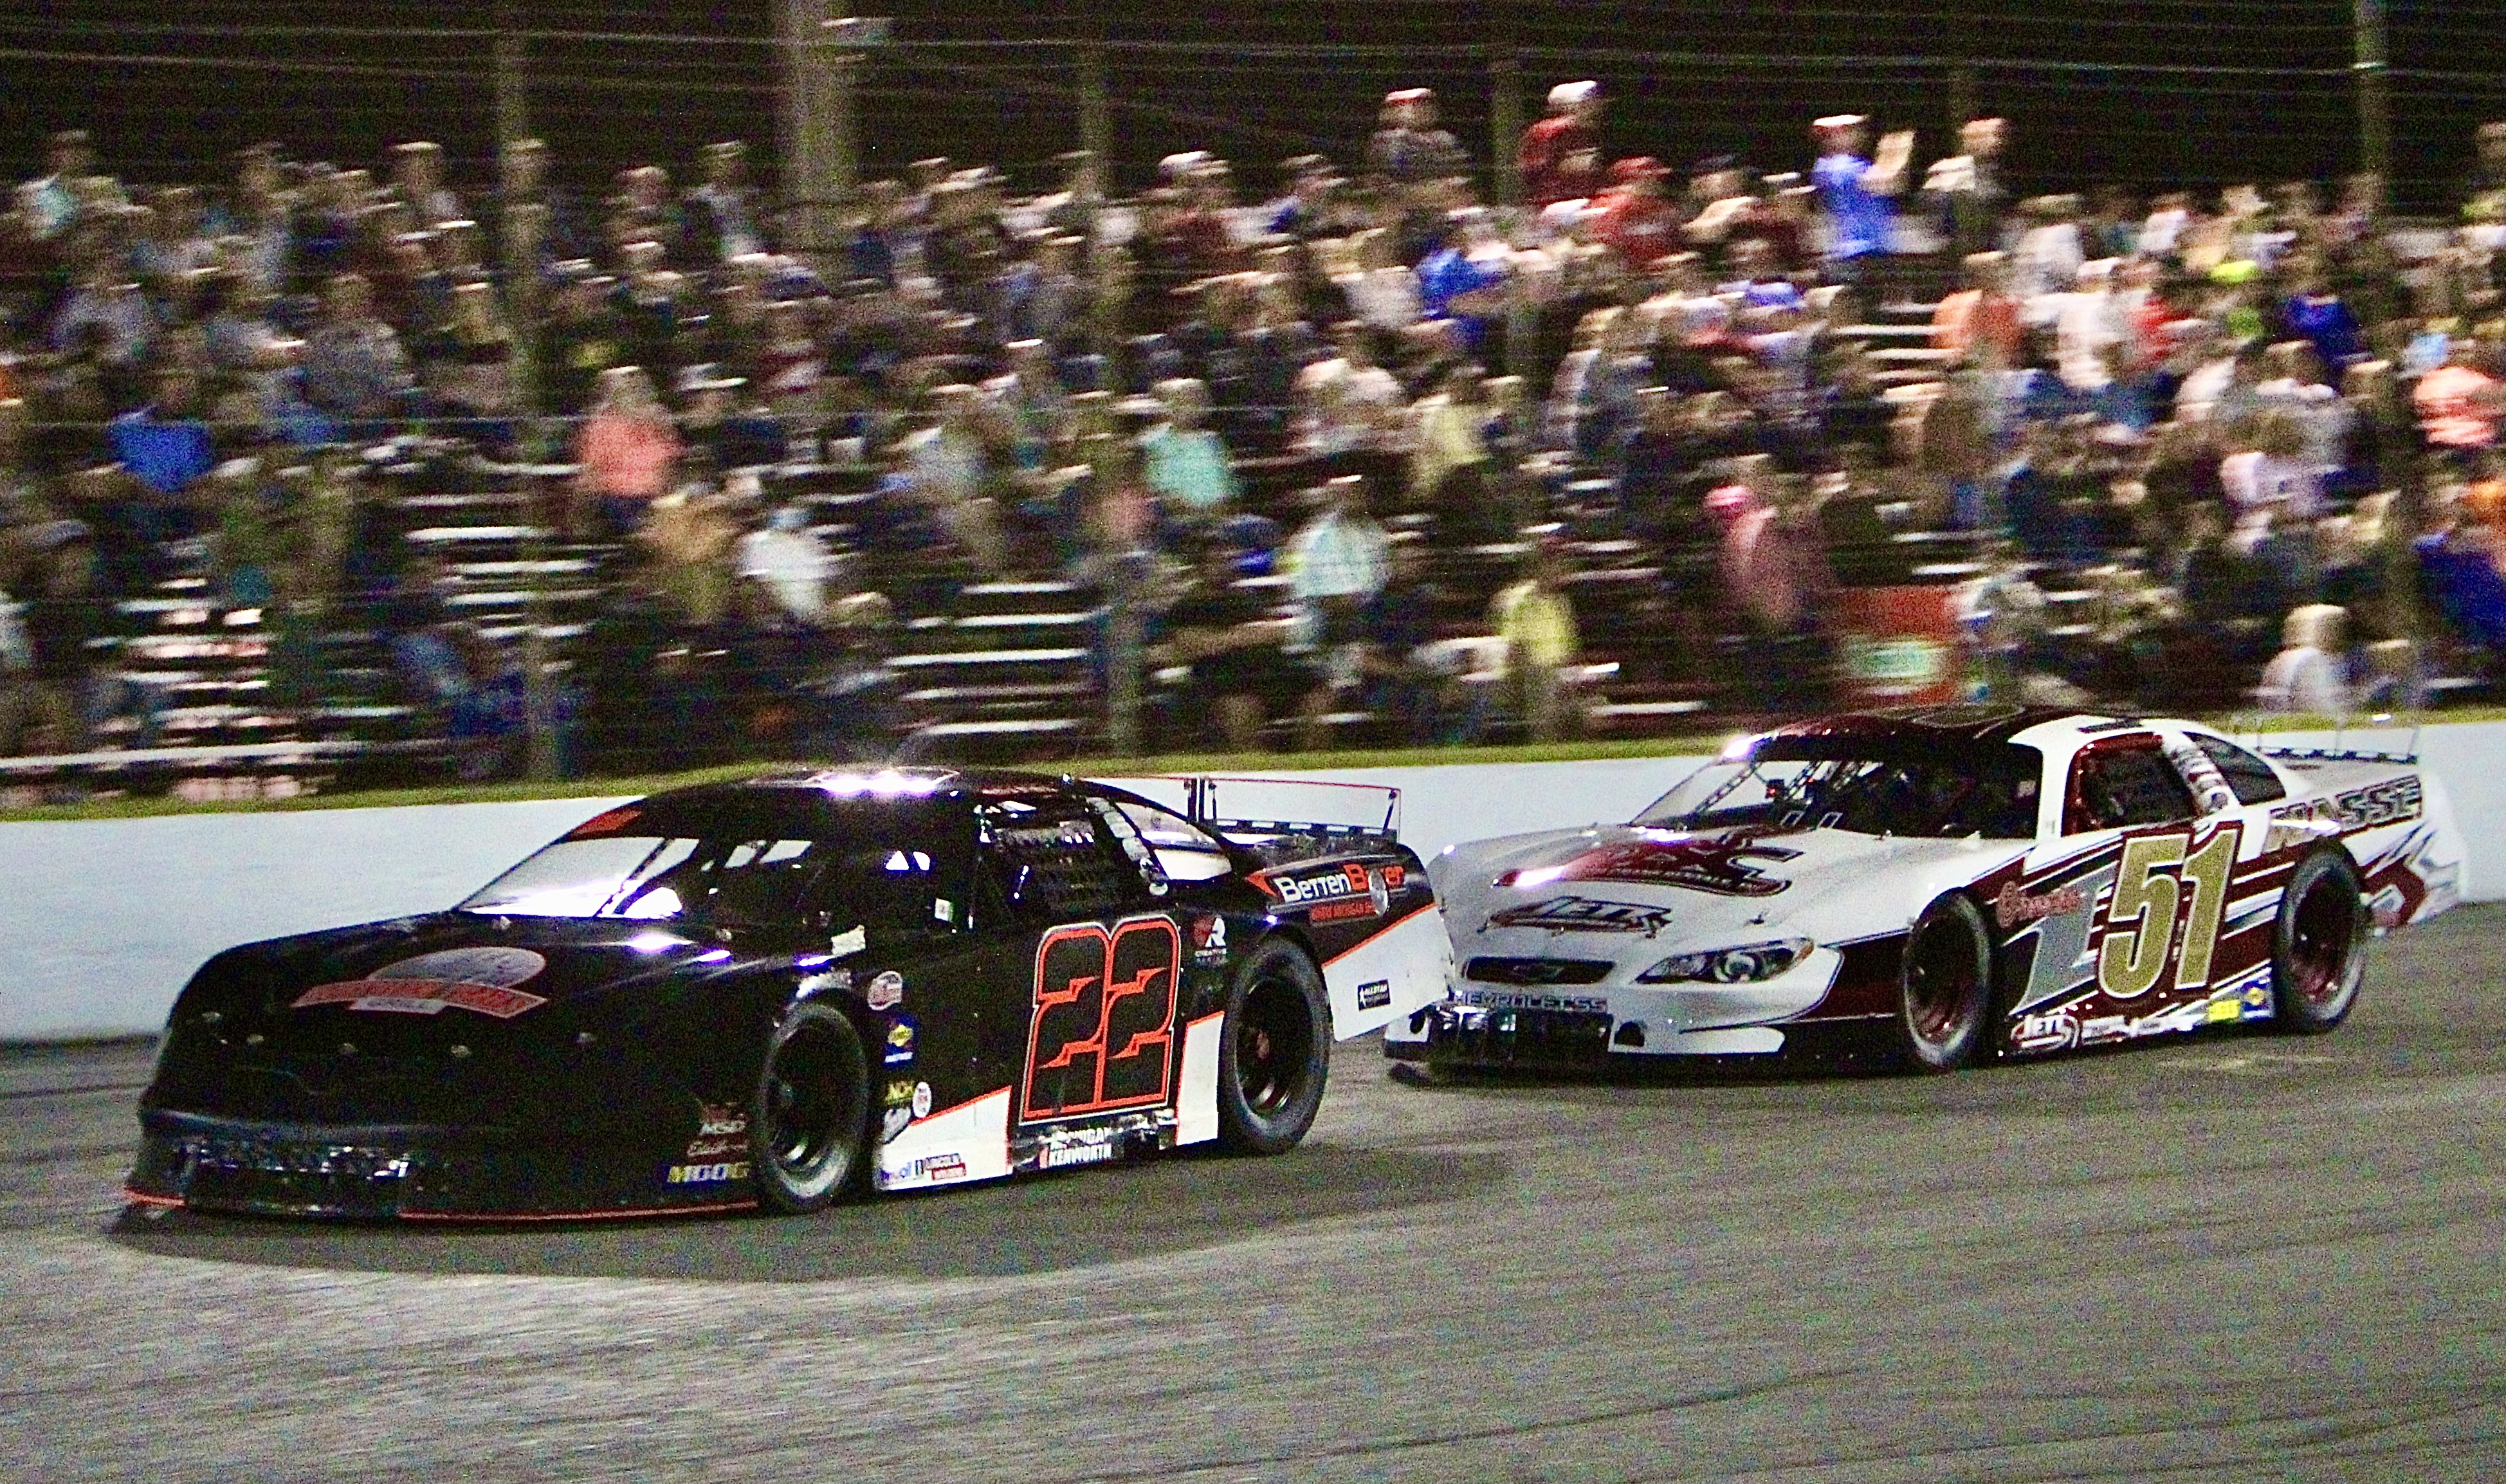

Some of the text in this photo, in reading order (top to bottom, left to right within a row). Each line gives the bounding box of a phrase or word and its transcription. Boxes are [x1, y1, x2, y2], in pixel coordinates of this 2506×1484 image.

[2099, 829, 2240, 998] 51
[1020, 913, 1182, 1126] 22
[1048, 1143, 1113, 1167] KENWORTH
